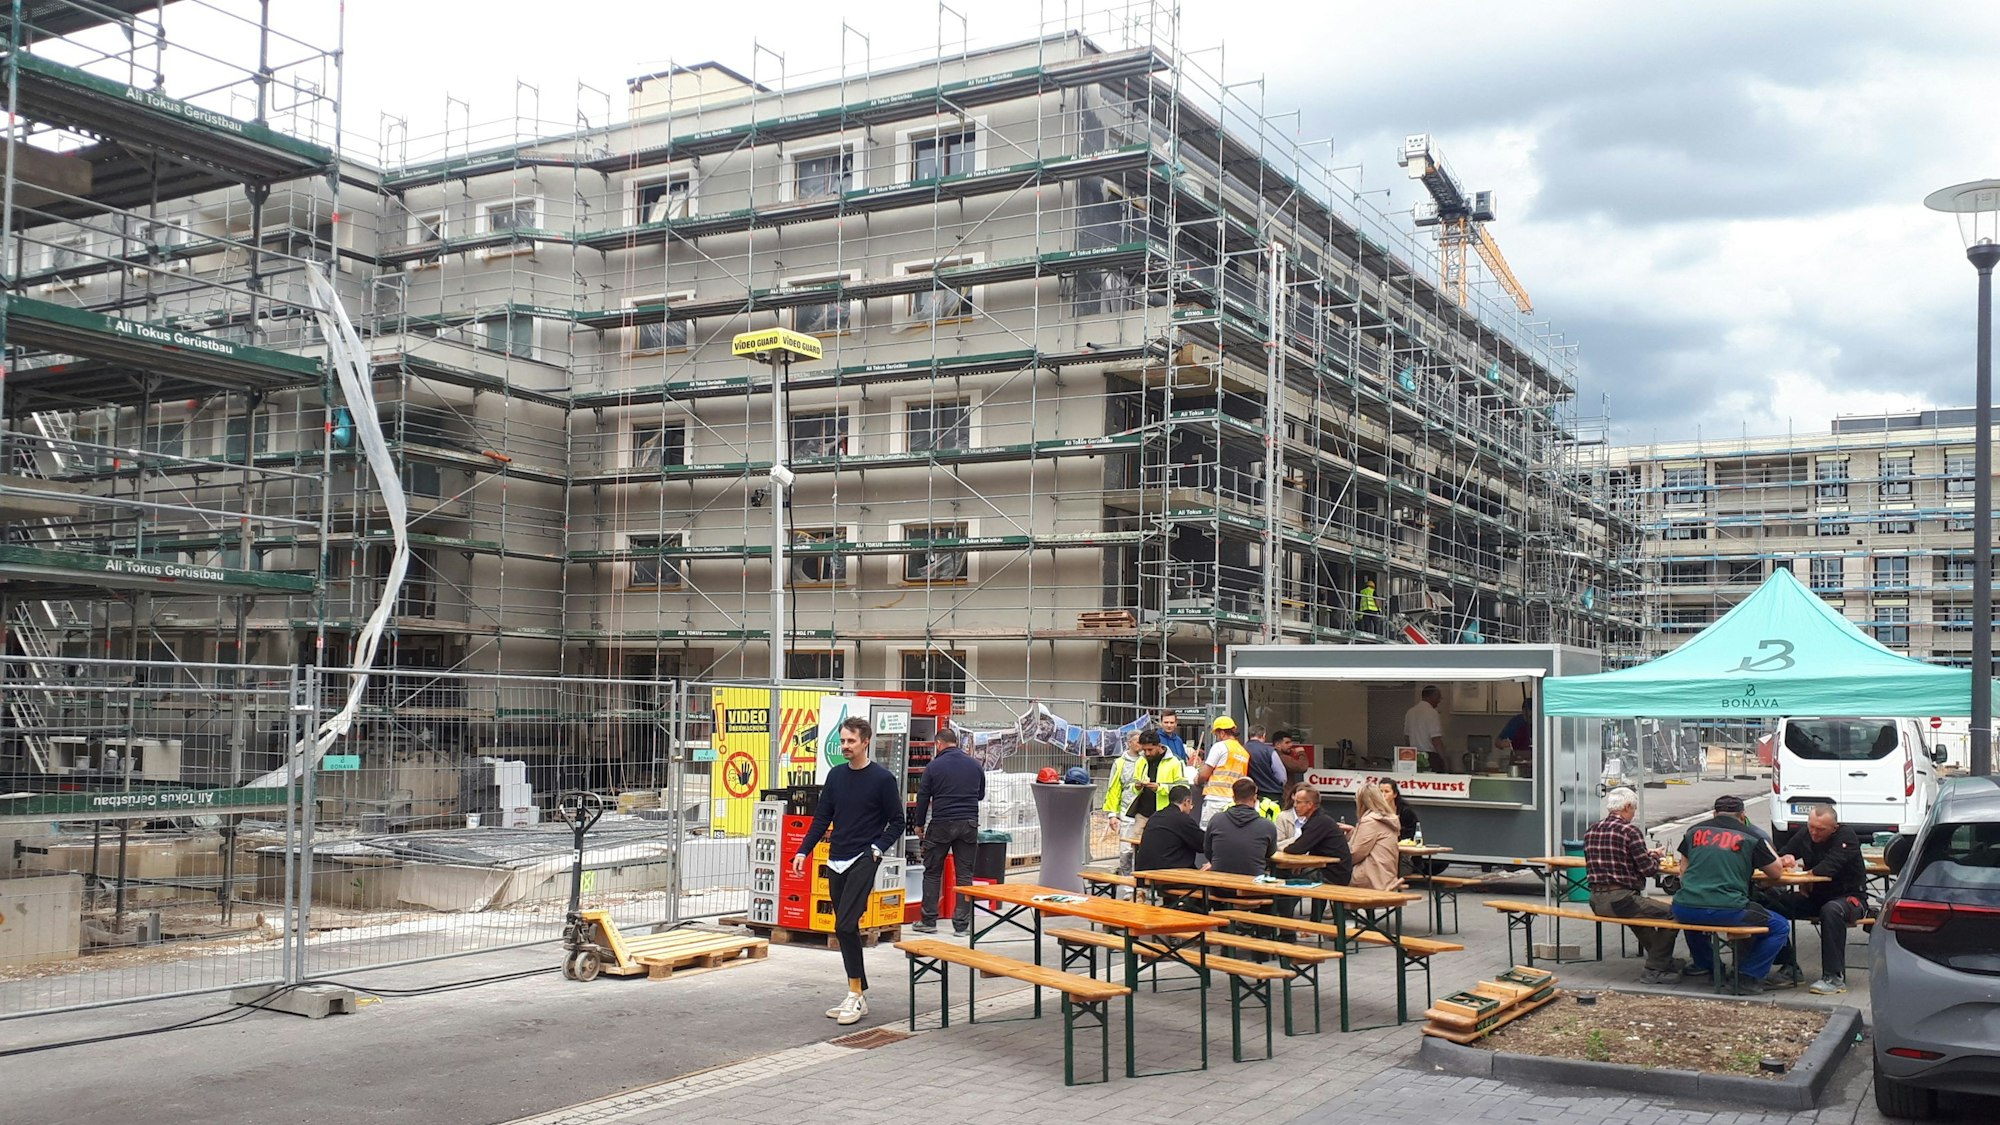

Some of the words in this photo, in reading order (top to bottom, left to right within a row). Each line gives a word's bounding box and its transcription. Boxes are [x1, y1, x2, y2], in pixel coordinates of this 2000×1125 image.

[126, 87, 143, 102] Ali
[146, 92, 181, 113] Tokus
[184, 105, 243, 132] Gerüstbau
[115, 320, 132, 334] Ali
[135, 324, 171, 342] Tokus
[174, 332, 233, 355] Gerüstbau
[756, 336, 778, 346] GUARD
[801, 342, 821, 355] GUARD
[105, 560, 122, 571] Ali
[125, 561, 161, 575] Tokus
[165, 564, 224, 581] Gerüstbau
[1721, 698, 1779, 708] BONAVA
[728, 710, 768, 724] VIDEO
[1308, 774, 1353, 788] Curry
[1397, 779, 1465, 792] atwurst
[93, 794, 157, 807] Gerüstbau
[160, 793, 195, 805] Tokus
[198, 791, 214, 804] Ali
